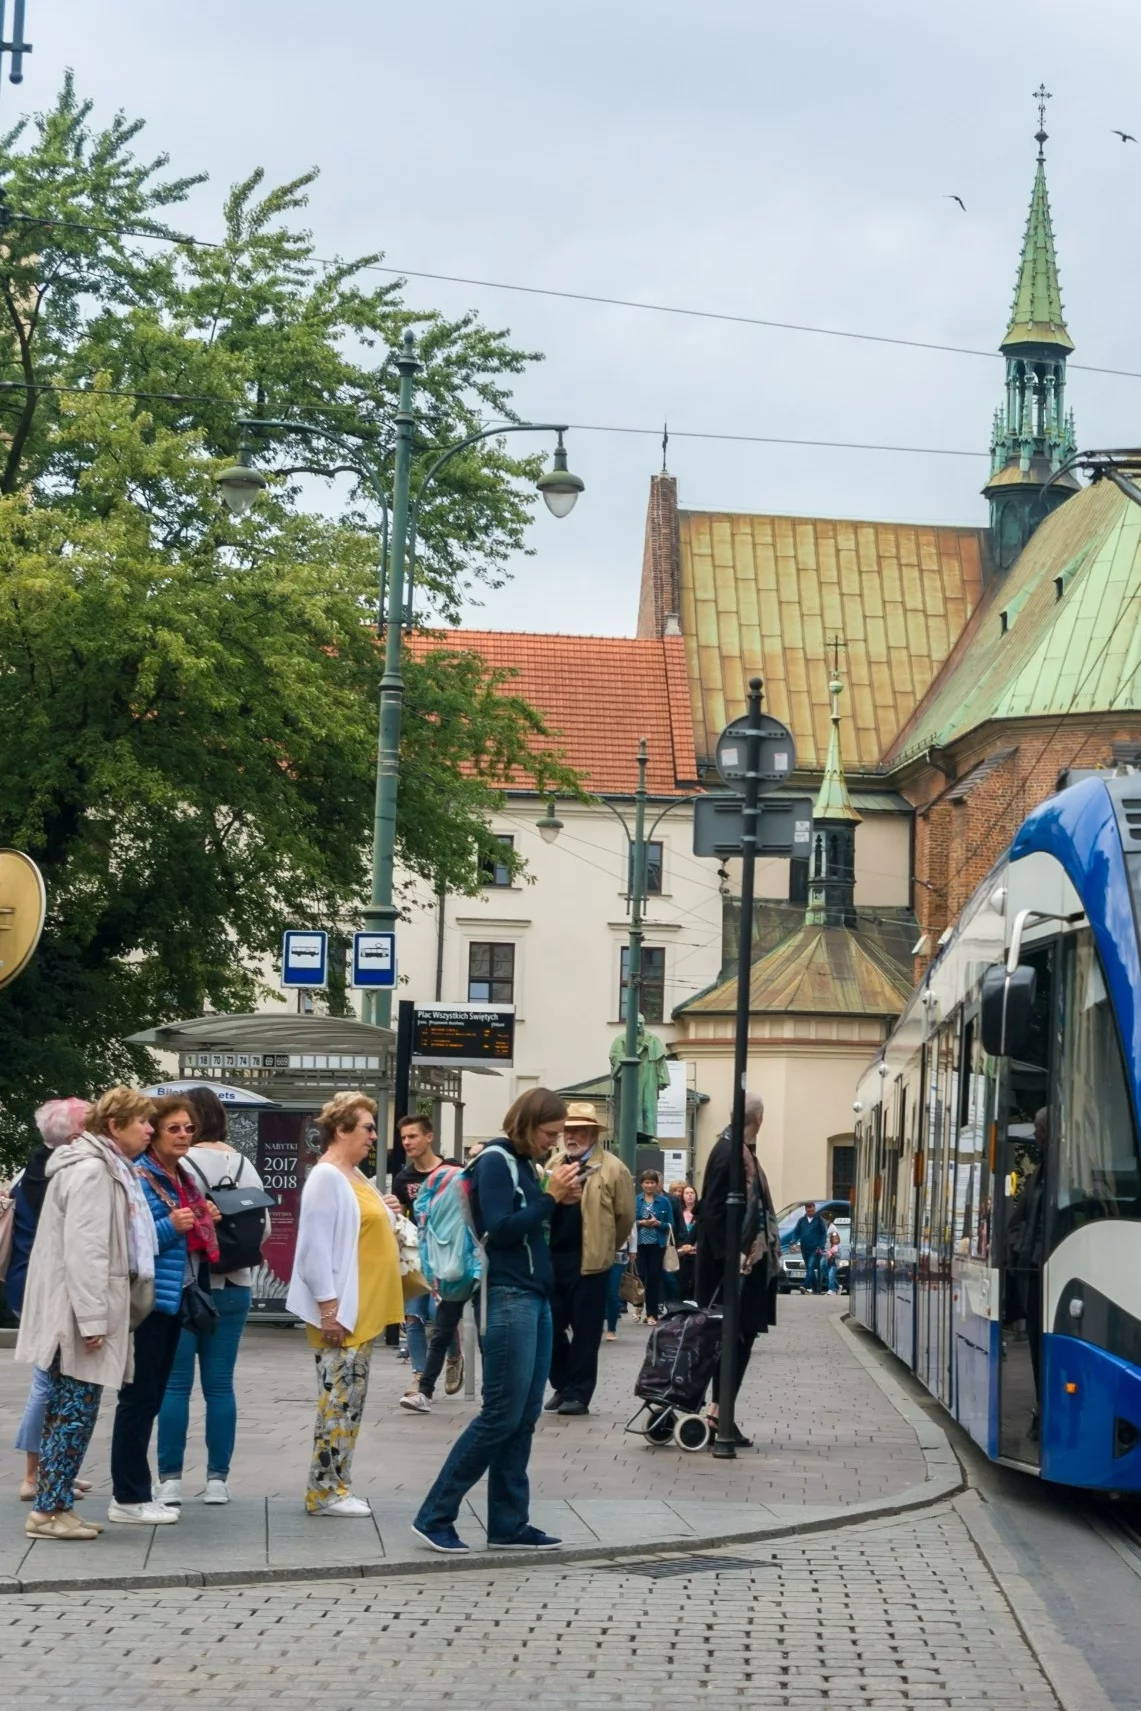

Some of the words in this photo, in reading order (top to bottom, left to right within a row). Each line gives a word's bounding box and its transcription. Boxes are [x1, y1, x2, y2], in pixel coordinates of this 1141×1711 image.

[418, 1010, 431, 1019] Plac
[432, 1011, 468, 1020] Wszystkich
[264, 1157, 298, 1171] 2017
[263, 1175, 297, 1189] 2018
